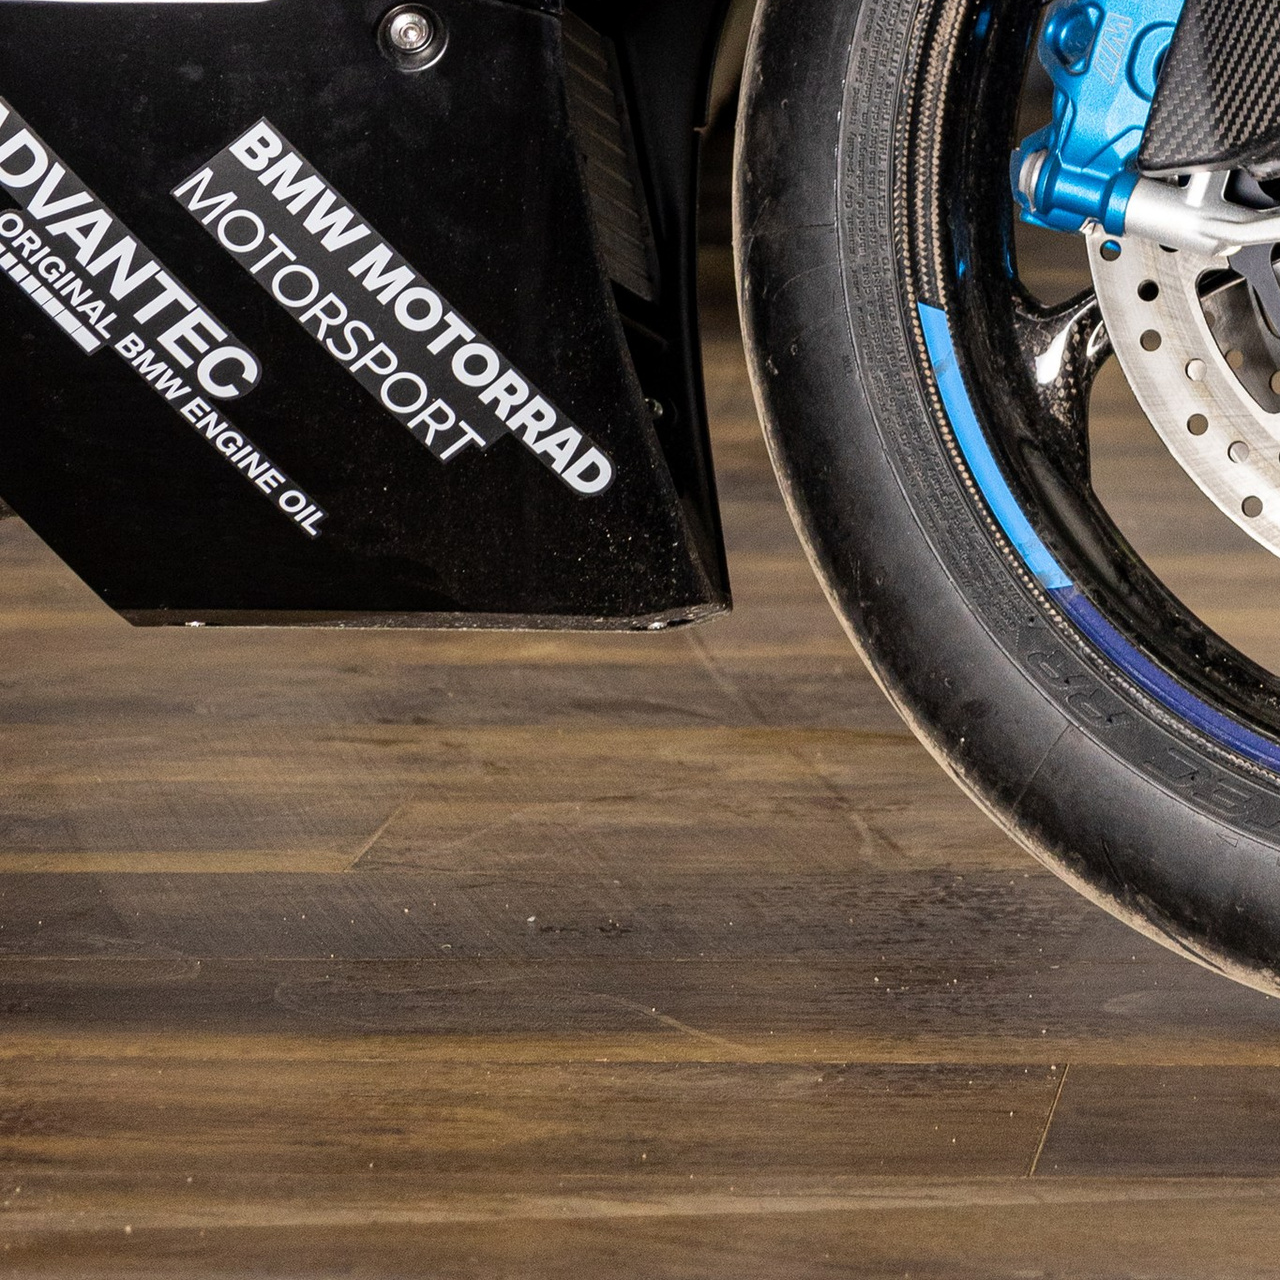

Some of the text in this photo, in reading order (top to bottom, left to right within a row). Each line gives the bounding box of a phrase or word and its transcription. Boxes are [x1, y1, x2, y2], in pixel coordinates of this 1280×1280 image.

[0, 103, 258, 398] DVANTEC
[0, 212, 328, 536] ORIGINAL BMW ENGINE OIL
[174, 167, 486, 462] MOTORSPORT
[229, 128, 612, 495] BMW MOTORRAD
